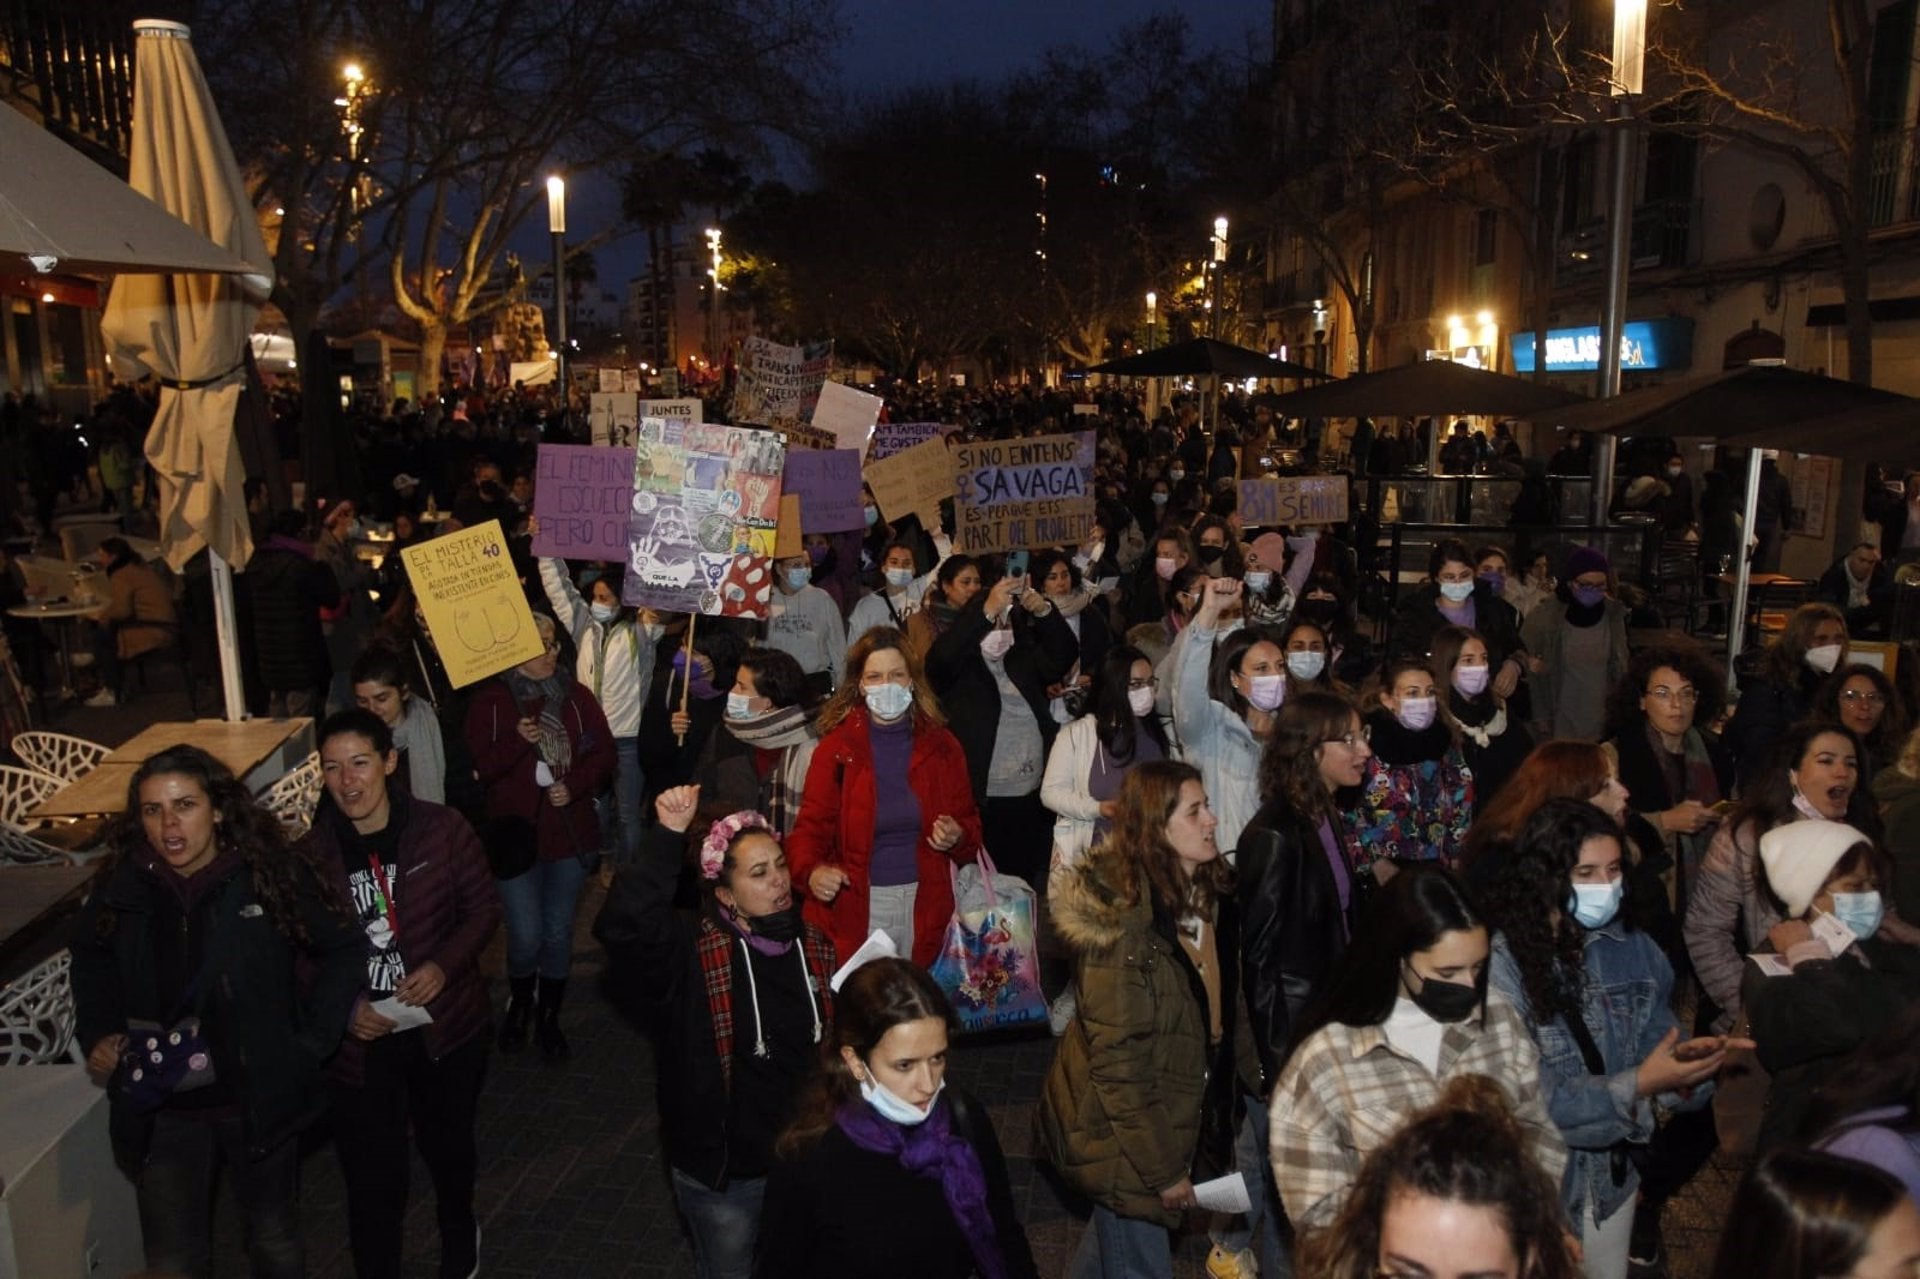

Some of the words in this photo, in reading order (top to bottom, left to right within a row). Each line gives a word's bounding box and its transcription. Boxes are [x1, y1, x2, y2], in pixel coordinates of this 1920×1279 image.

[650, 405, 691, 415] JUNTES
[539, 453, 563, 480] EL
[569, 453, 636, 482] FEMINI
[980, 447, 1001, 467] NO
[1009, 442, 1075, 466] ENTENS
[539, 516, 593, 546] PERO
[964, 522, 1002, 549] PART
[410, 548, 432, 567] EL
[436, 531, 496, 556] MISTERIO
[440, 553, 479, 573] TALLA
[483, 543, 500, 557] 40
[961, 1009, 1029, 1030] allorca
